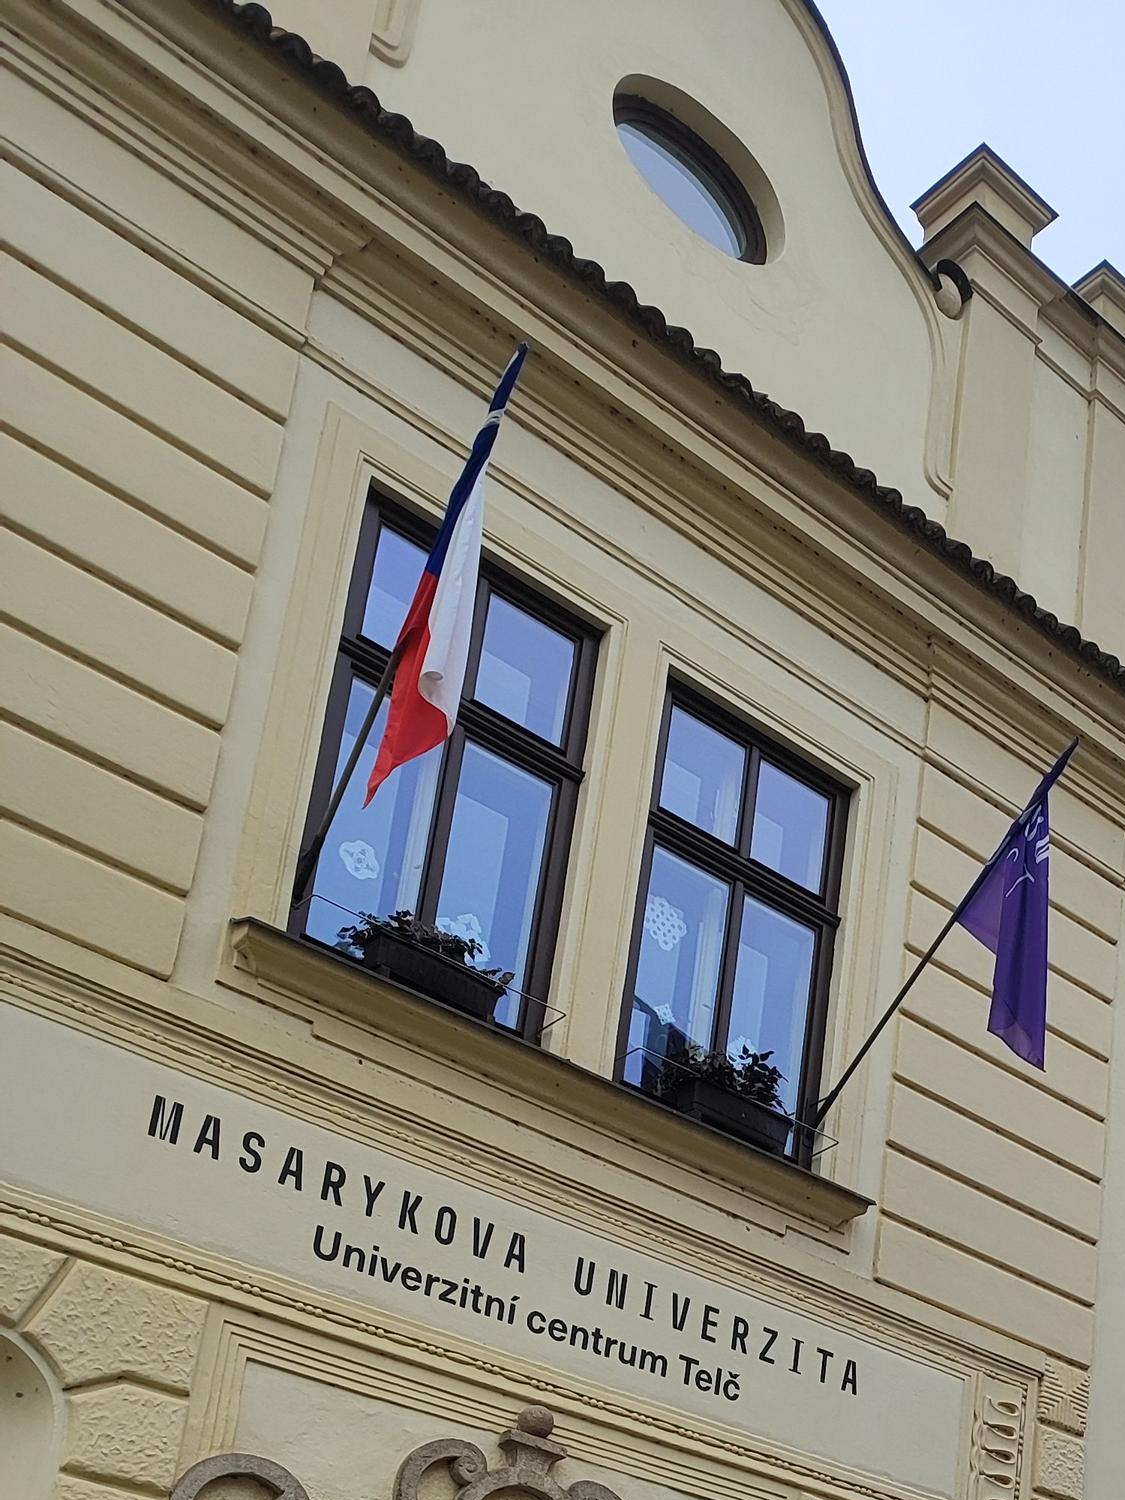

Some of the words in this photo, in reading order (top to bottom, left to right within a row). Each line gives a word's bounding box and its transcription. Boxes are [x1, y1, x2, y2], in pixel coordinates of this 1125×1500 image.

[148, 1095, 525, 1273] MASARYKOVA
[574, 1257, 857, 1395] UNIVERZITA
[313, 1224, 520, 1325] Univerzitní
[527, 1310, 668, 1377] centrum
[679, 1354, 740, 1401] Telč
